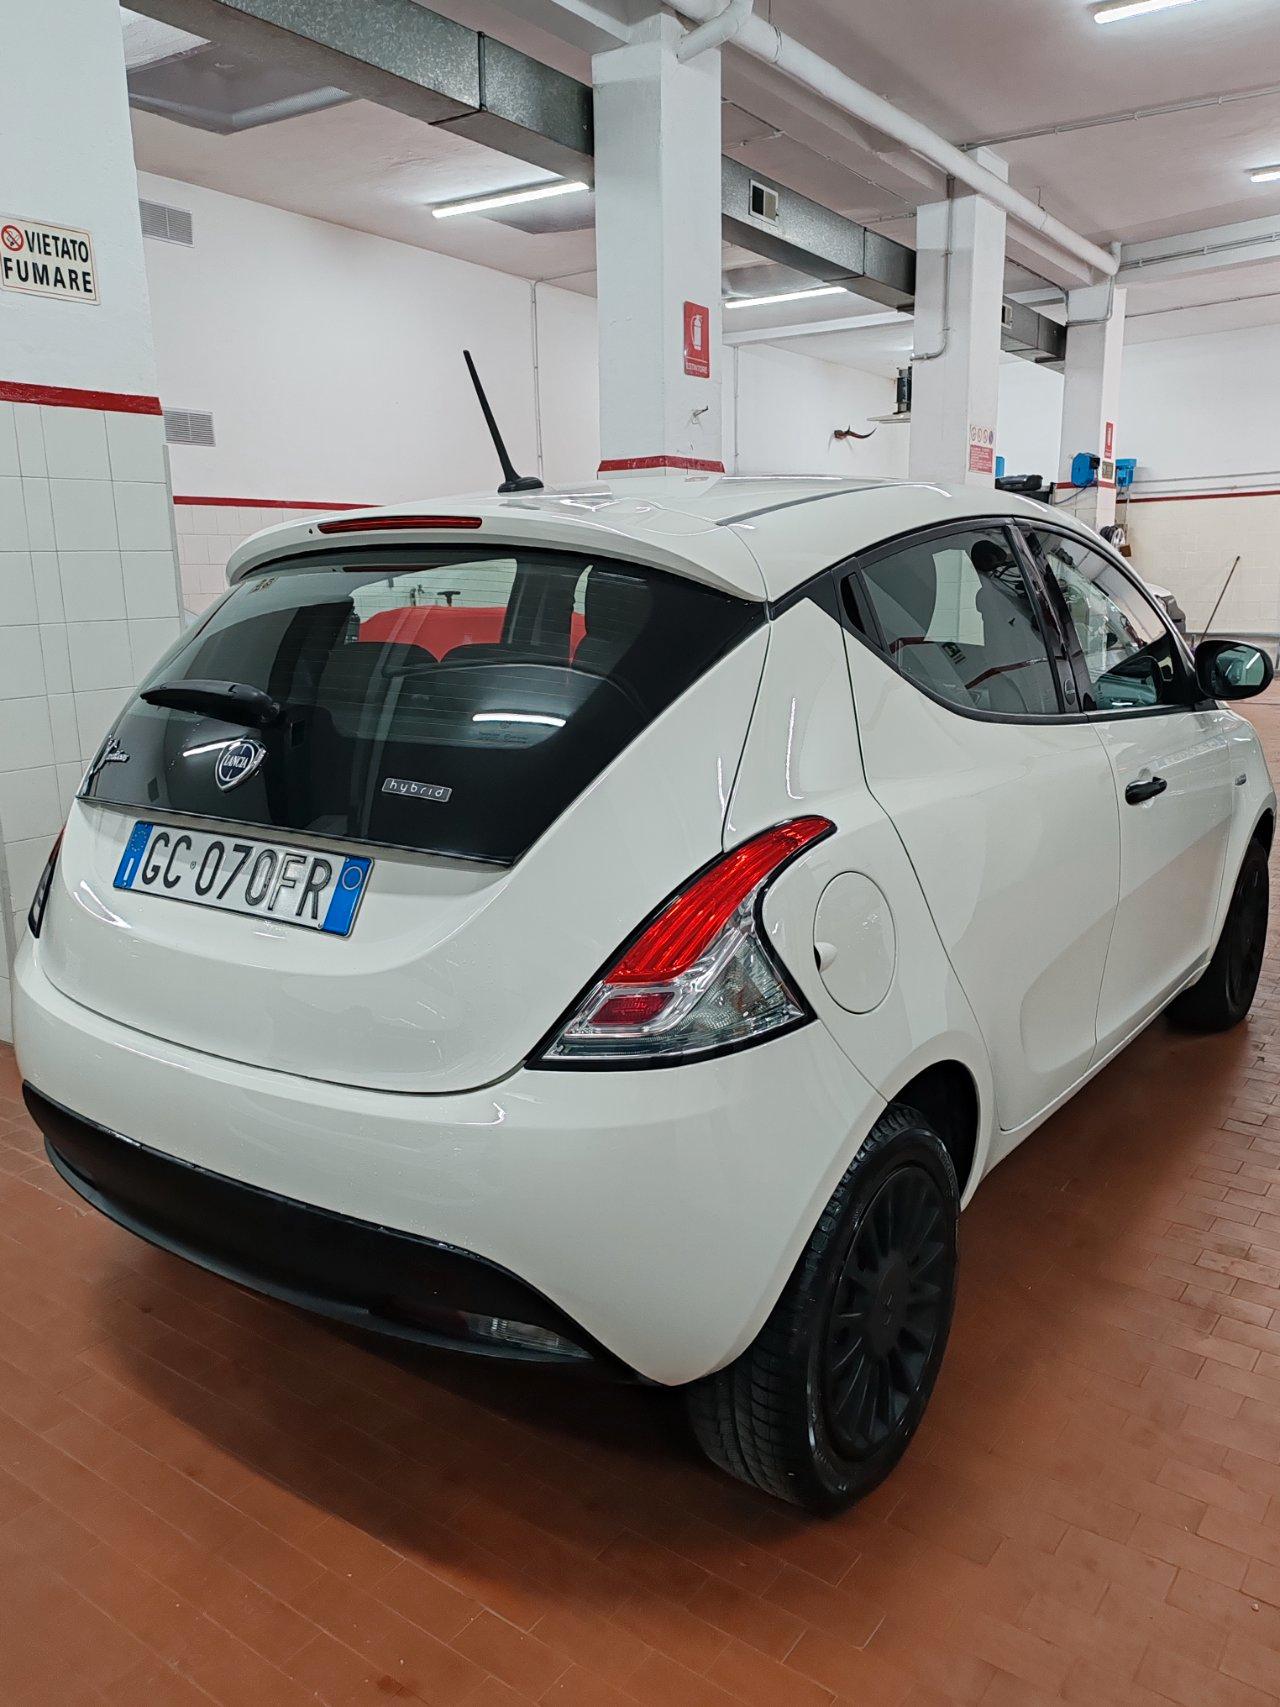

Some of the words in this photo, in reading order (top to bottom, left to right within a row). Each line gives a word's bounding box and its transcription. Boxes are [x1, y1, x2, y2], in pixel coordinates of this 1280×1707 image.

[24, 229, 89, 263] VIETATO
[3, 256, 93, 293] FUMARE
[223, 754, 249, 769] LANCIA
[389, 779, 444, 797] hybrid
